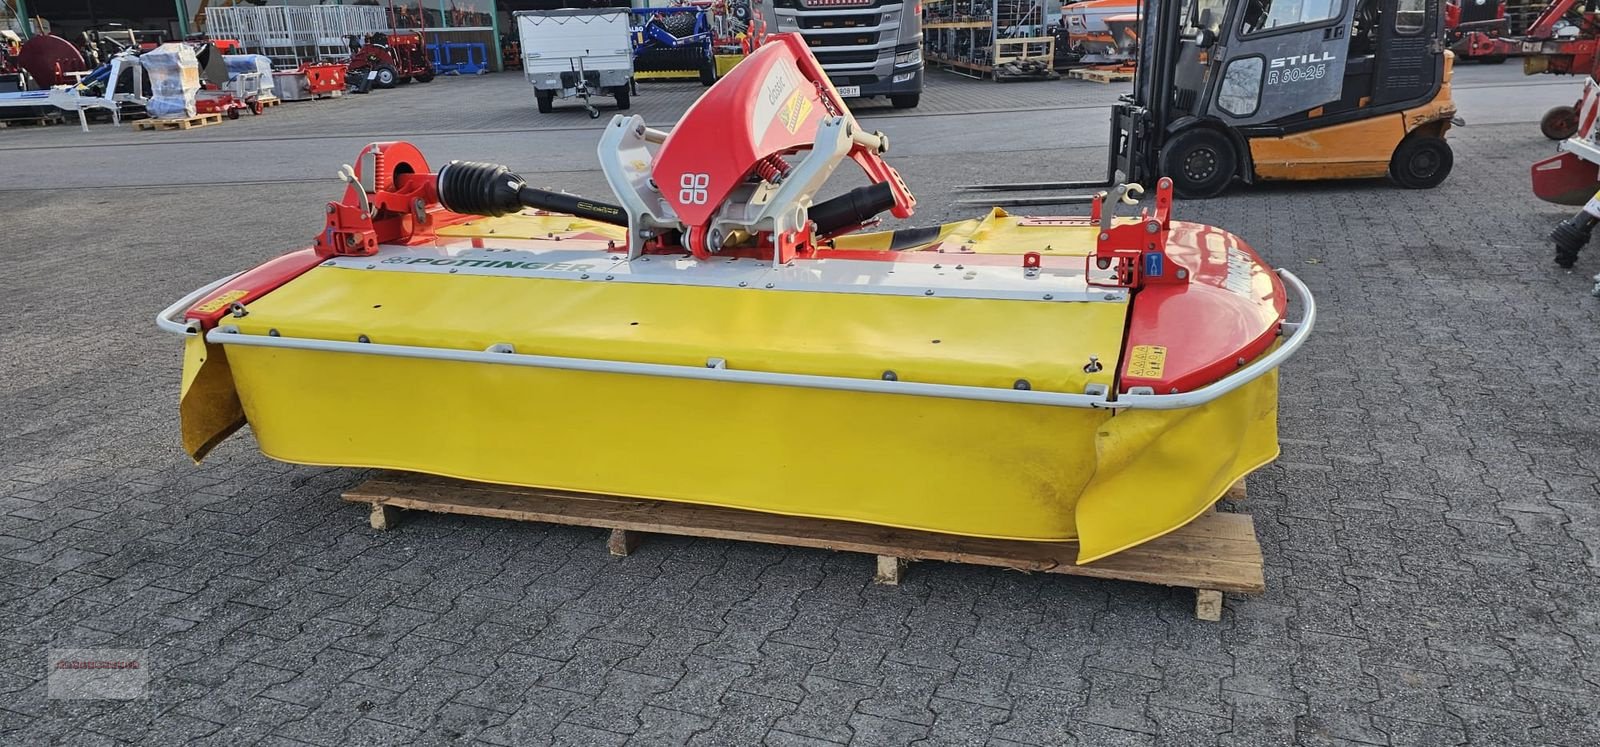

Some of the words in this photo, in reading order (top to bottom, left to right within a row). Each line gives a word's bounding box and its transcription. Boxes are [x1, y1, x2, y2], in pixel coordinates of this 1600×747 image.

[1270, 51, 1336, 68] STILL
[1268, 70, 1280, 85] R
[1281, 63, 1326, 83] 60-25
